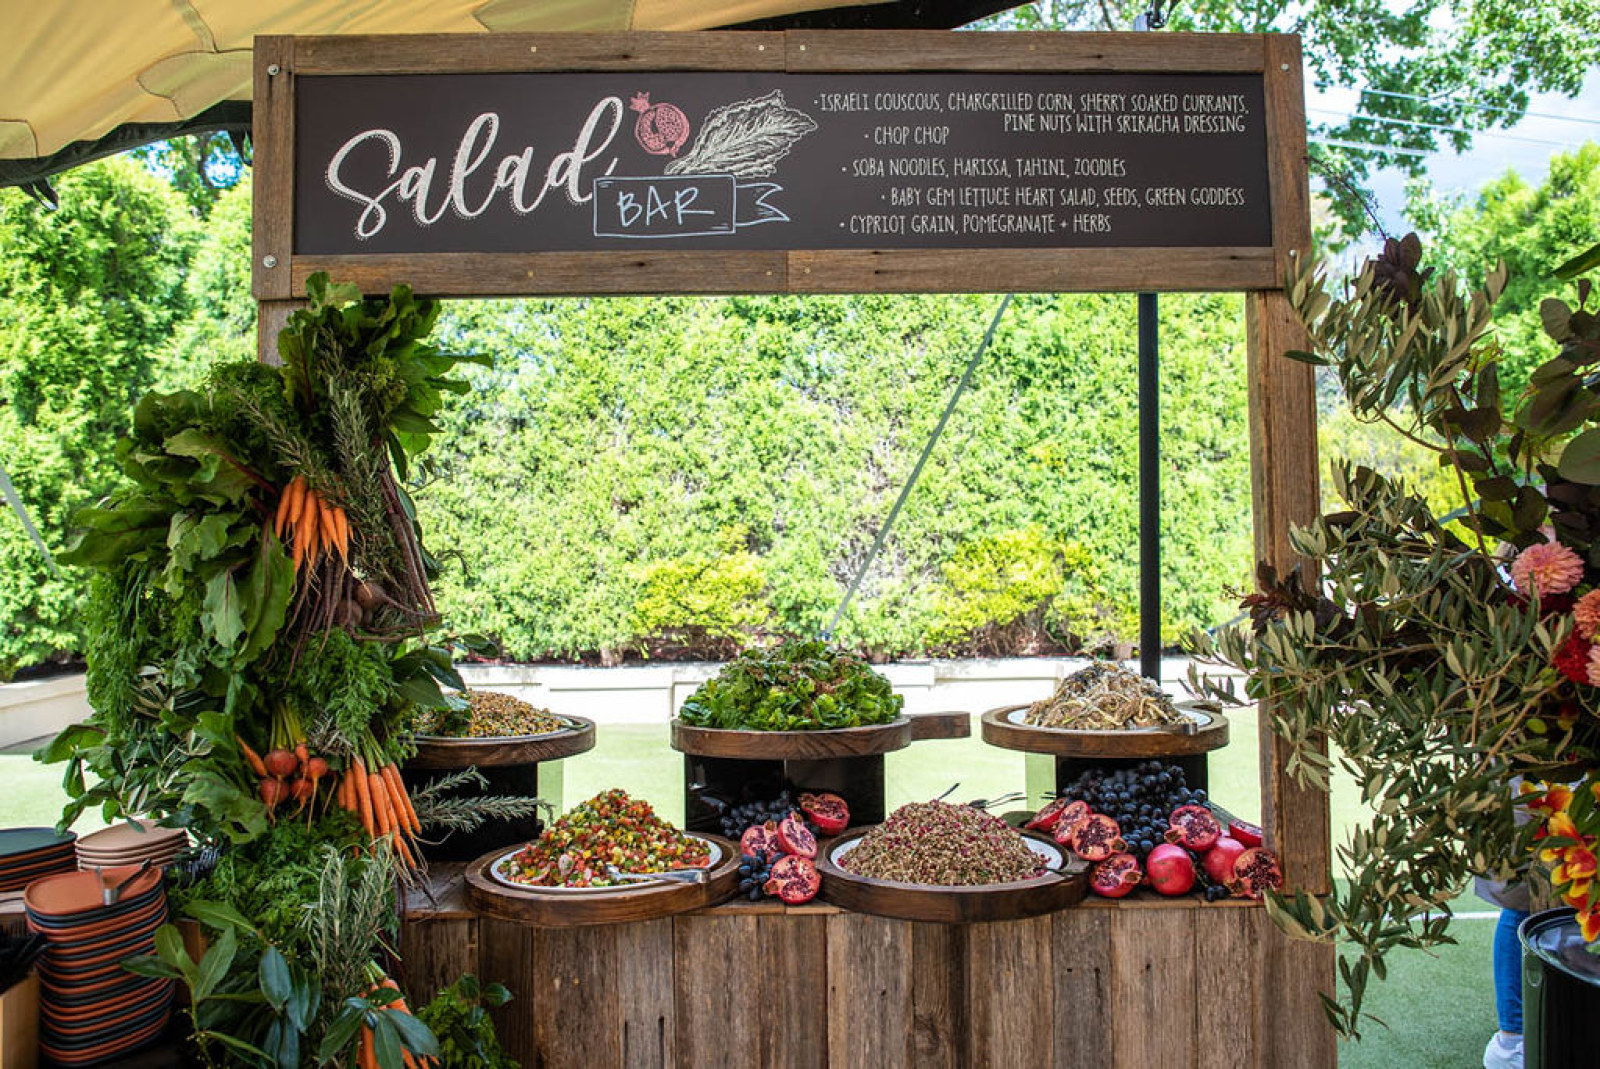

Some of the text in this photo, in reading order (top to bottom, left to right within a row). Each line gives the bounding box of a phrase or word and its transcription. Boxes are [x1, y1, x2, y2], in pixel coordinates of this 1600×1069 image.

[820, 93, 1248, 114] ISRAELI COUSCOUS, CHARGRILLED CORN, SHERRY SOAKED CURRANTS,
[1005, 114, 1245, 133] PINE NUTS WITH SRIRACHA DRESSING
[875, 126, 949, 145] CHOP CHOP
[325, 95, 624, 240] Salad
[853, 158, 1125, 178] SOBA NOODLES, HARISSA, TAHINI, ZOODLES
[617, 186, 715, 227] BAR
[892, 187, 1244, 207] BABY GEM LETTUCE HEART SALAD, SEEDS, GREEN GODDESS
[850, 215, 905, 234] CYPRIOT
[911, 215, 958, 234] GRAIN,
[964, 215, 1054, 233] POMEGRANATE
[1074, 214, 1111, 232] HERBS
